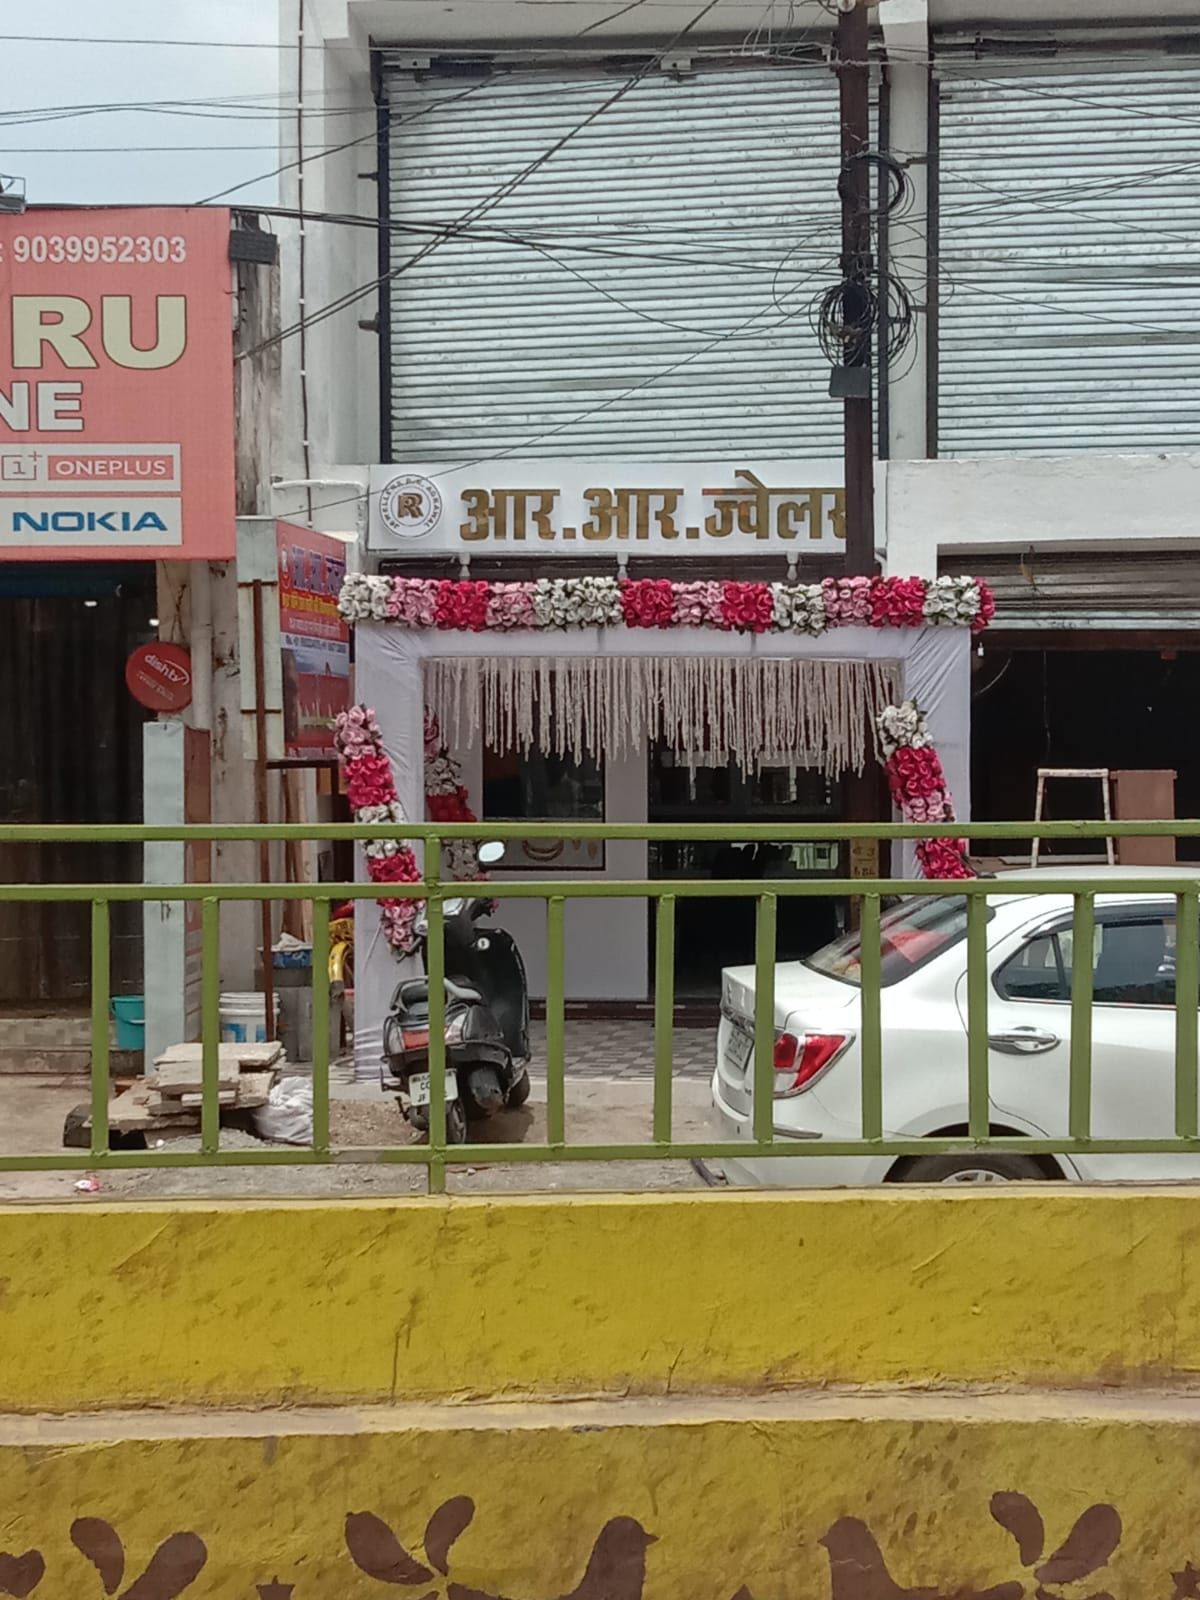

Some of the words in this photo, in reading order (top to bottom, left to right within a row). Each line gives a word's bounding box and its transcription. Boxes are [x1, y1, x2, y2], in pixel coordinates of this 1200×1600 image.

[13, 235, 187, 264] 9039952303
[55, 459, 167, 476] ONEPLUS
[12, 511, 168, 532] NOKIA
